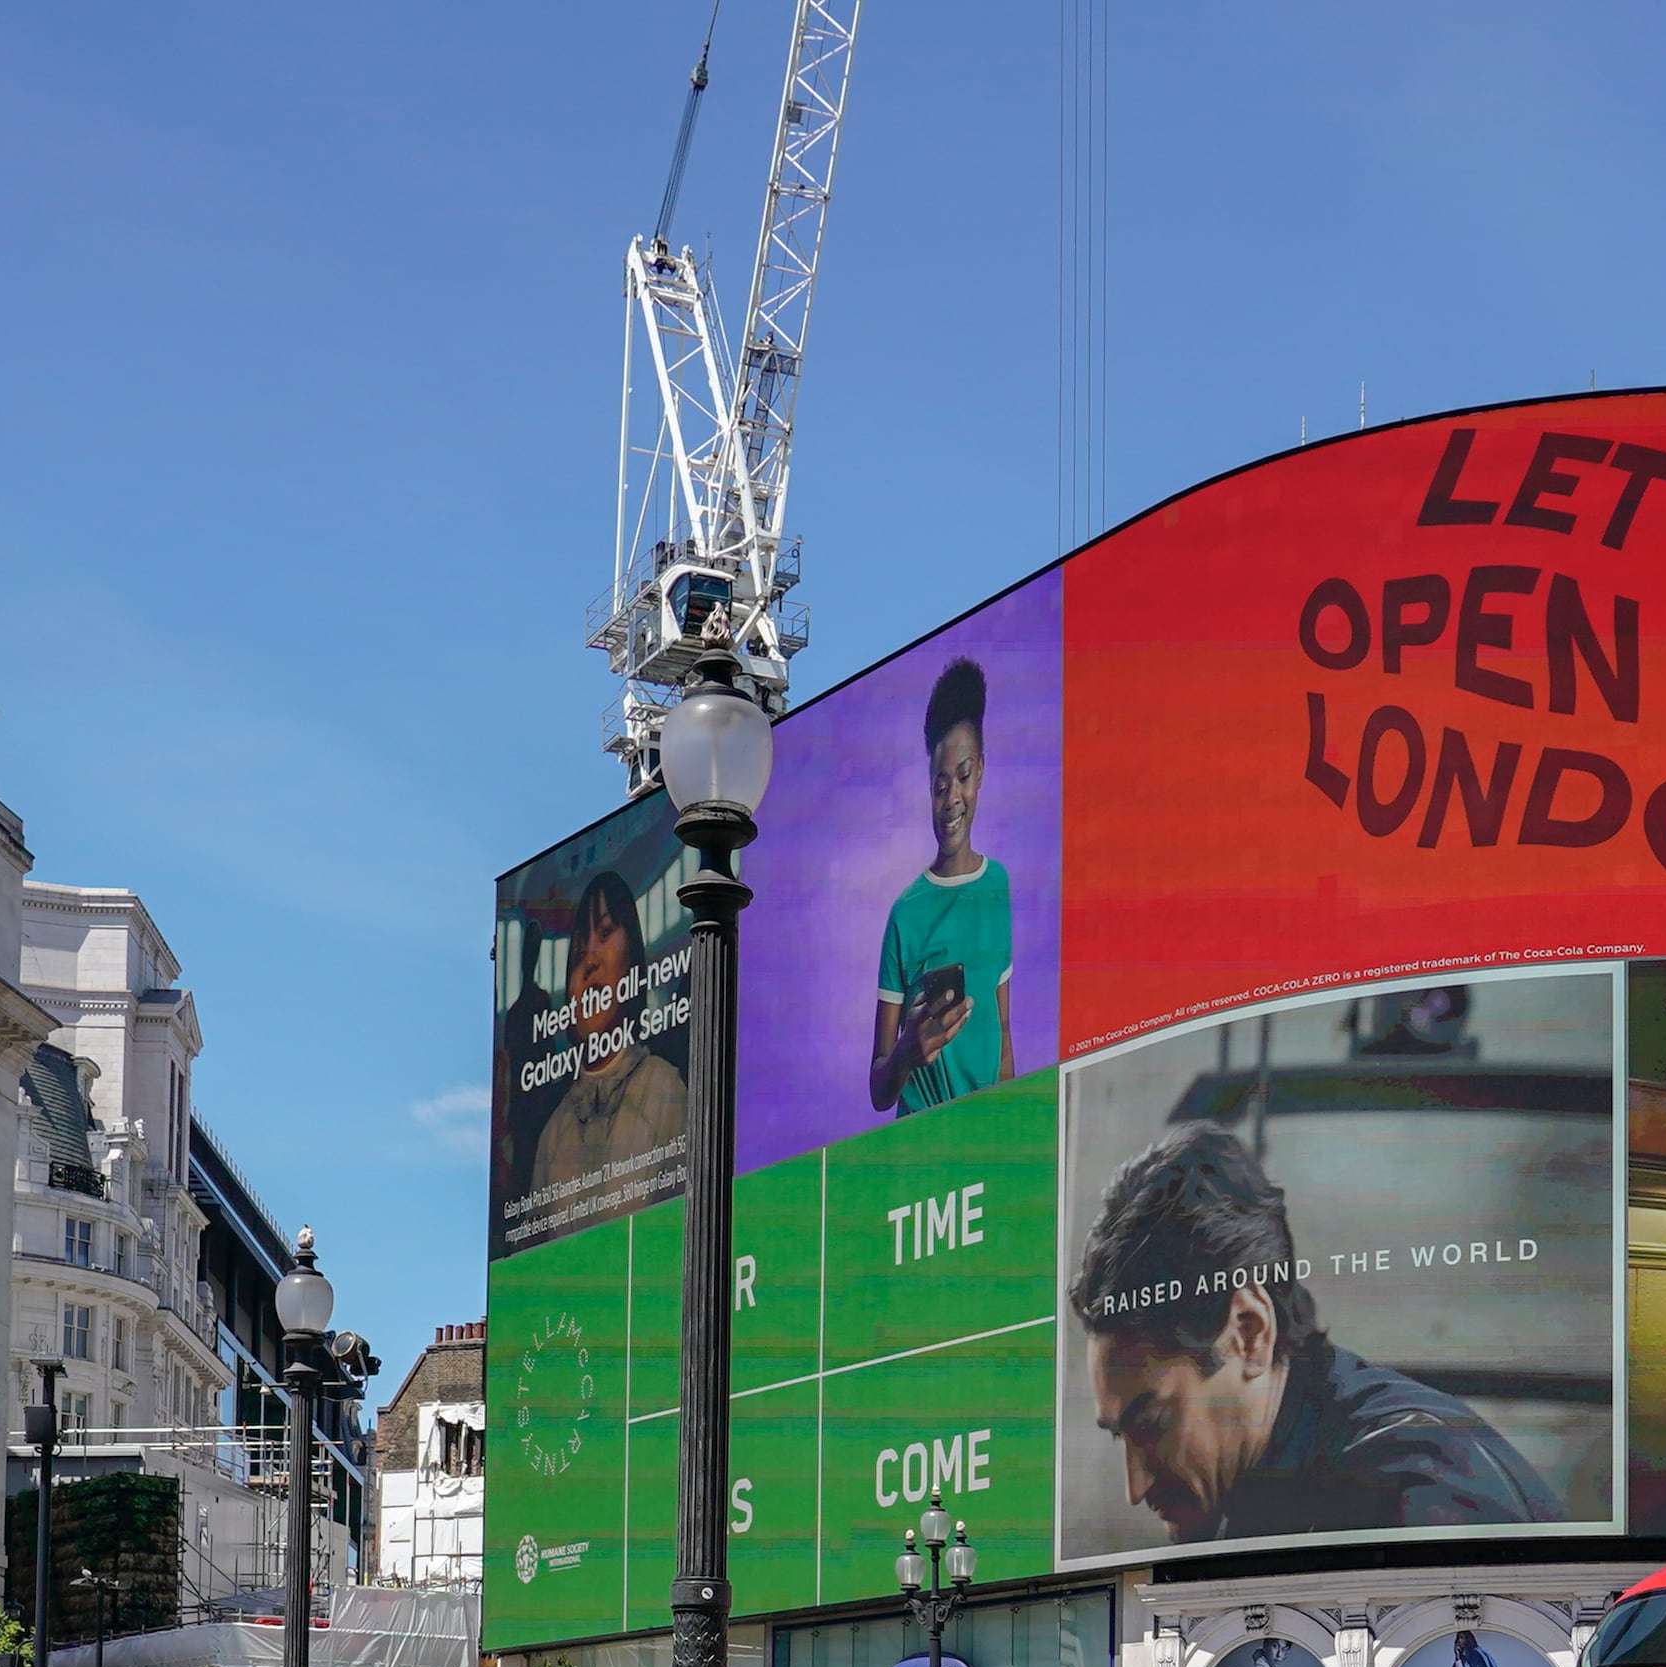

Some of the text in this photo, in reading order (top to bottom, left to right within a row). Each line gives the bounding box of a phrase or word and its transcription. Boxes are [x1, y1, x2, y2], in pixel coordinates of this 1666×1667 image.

[1298, 565, 1640, 723] OPEN
[532, 946, 693, 1044] Meet the all-new
[1075, 1039, 1091, 1052] 2021
[1091, 1034, 1105, 1047] The
[1139, 1012, 1174, 1033] Company.
[1174, 1006, 1185, 1018] All
[1185, 1000, 1210, 1015] rights
[1210, 990, 1252, 1008] reserved.
[1252, 977, 1311, 998] COCA-COLA
[1311, 971, 1342, 987] ZERO
[1342, 970, 1352, 981] is
[1354, 969, 1361, 979] a
[1362, 960, 1420, 979] registered
[1421, 953, 1482, 970] trademark
[1483, 949, 1497, 962] of
[1498, 949, 1521, 961] The
[1586, 942, 1646, 958] Company.
[520, 993, 692, 1092] Galaxy Book Serie
[887, 1181, 985, 1266] TIME
[1101, 1237, 1540, 1317] RAISED AROUND THE WORLD
[874, 1428, 991, 1508] COME
[567, 1541, 590, 1555] SOCIETY
